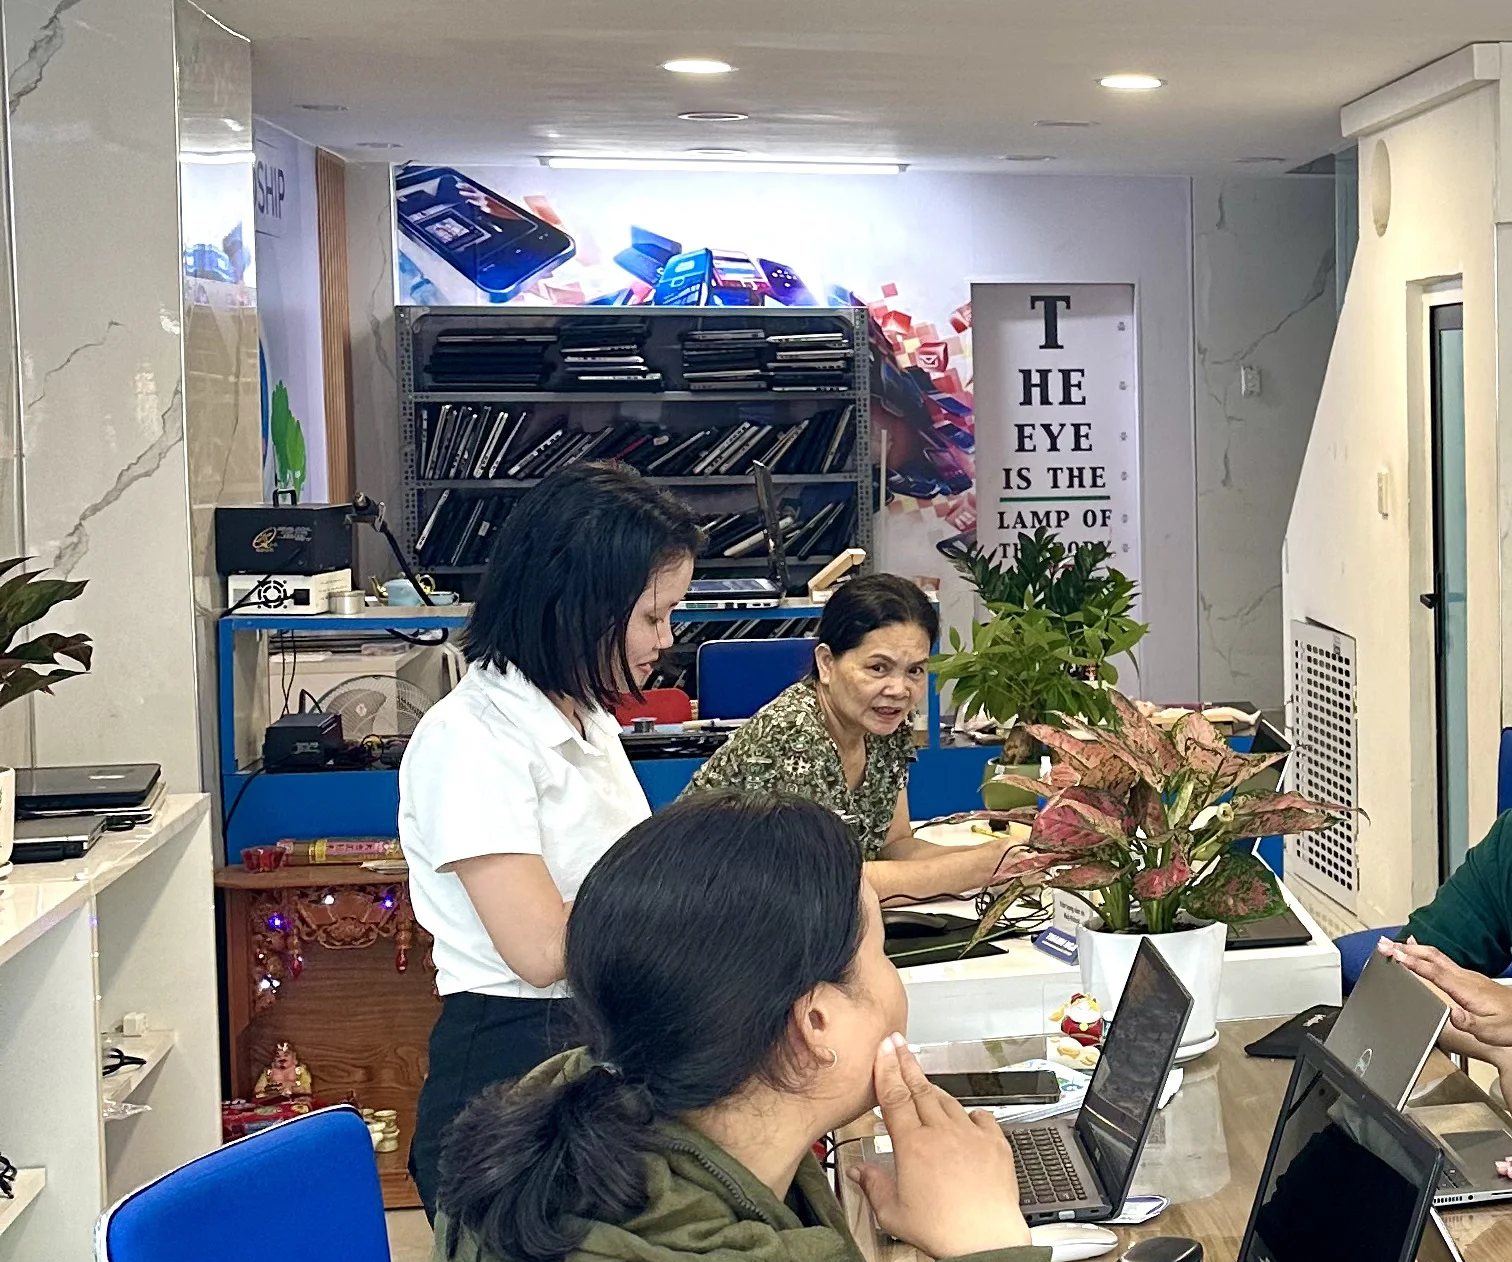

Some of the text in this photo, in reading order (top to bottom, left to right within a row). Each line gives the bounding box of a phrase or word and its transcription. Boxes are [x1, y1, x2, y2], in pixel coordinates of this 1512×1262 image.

[1030, 294, 1071, 349] T
[1018, 368, 1087, 406] HE
[1014, 422, 1093, 453] EYE
[1002, 467, 1032, 490] IS
[1047, 466, 1106, 489] THE
[997, 510, 1070, 529] LAMP
[1083, 509, 1113, 528] OF
